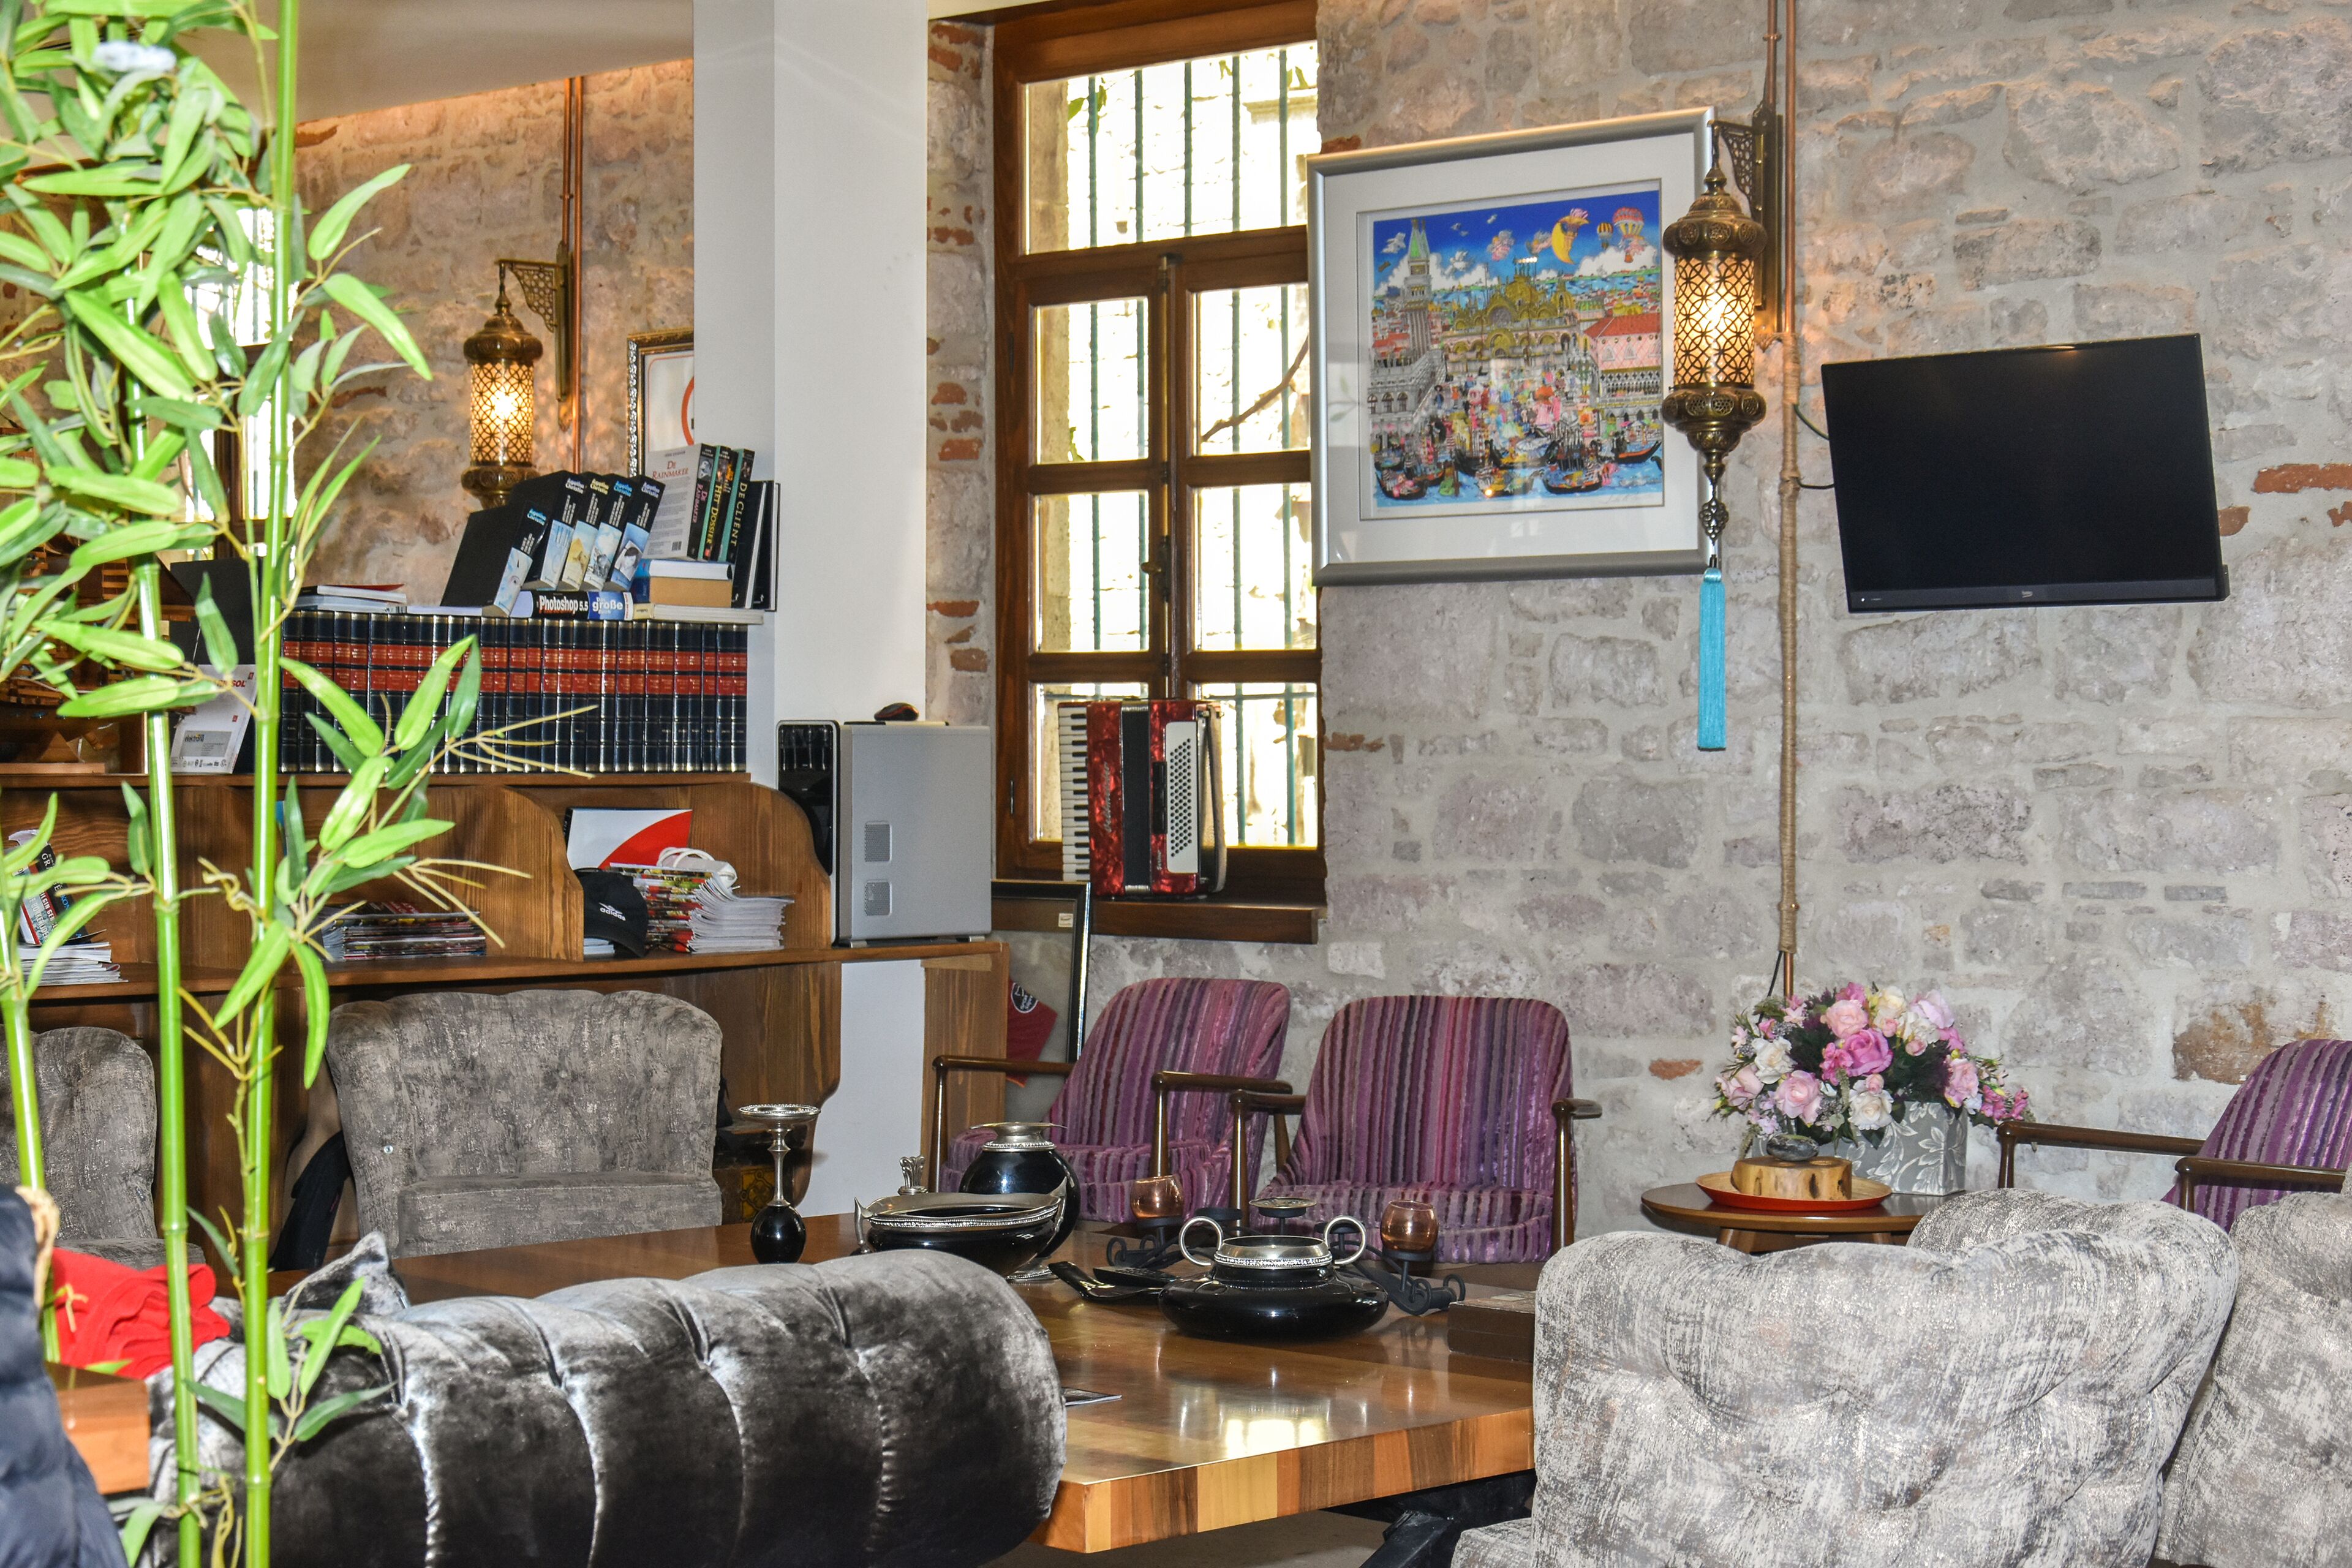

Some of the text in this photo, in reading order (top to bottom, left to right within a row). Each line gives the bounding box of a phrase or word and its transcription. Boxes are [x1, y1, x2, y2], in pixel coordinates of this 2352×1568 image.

[652, 467, 688, 480] RAINMAKER
[738, 482, 747, 499] DE
[706, 484, 722, 544] HET DOSSIER
[539, 595, 578, 614] Photoshop
[579, 600, 588, 611] 5.5
[592, 600, 623, 612] große
[600, 907, 626, 921] adidas
